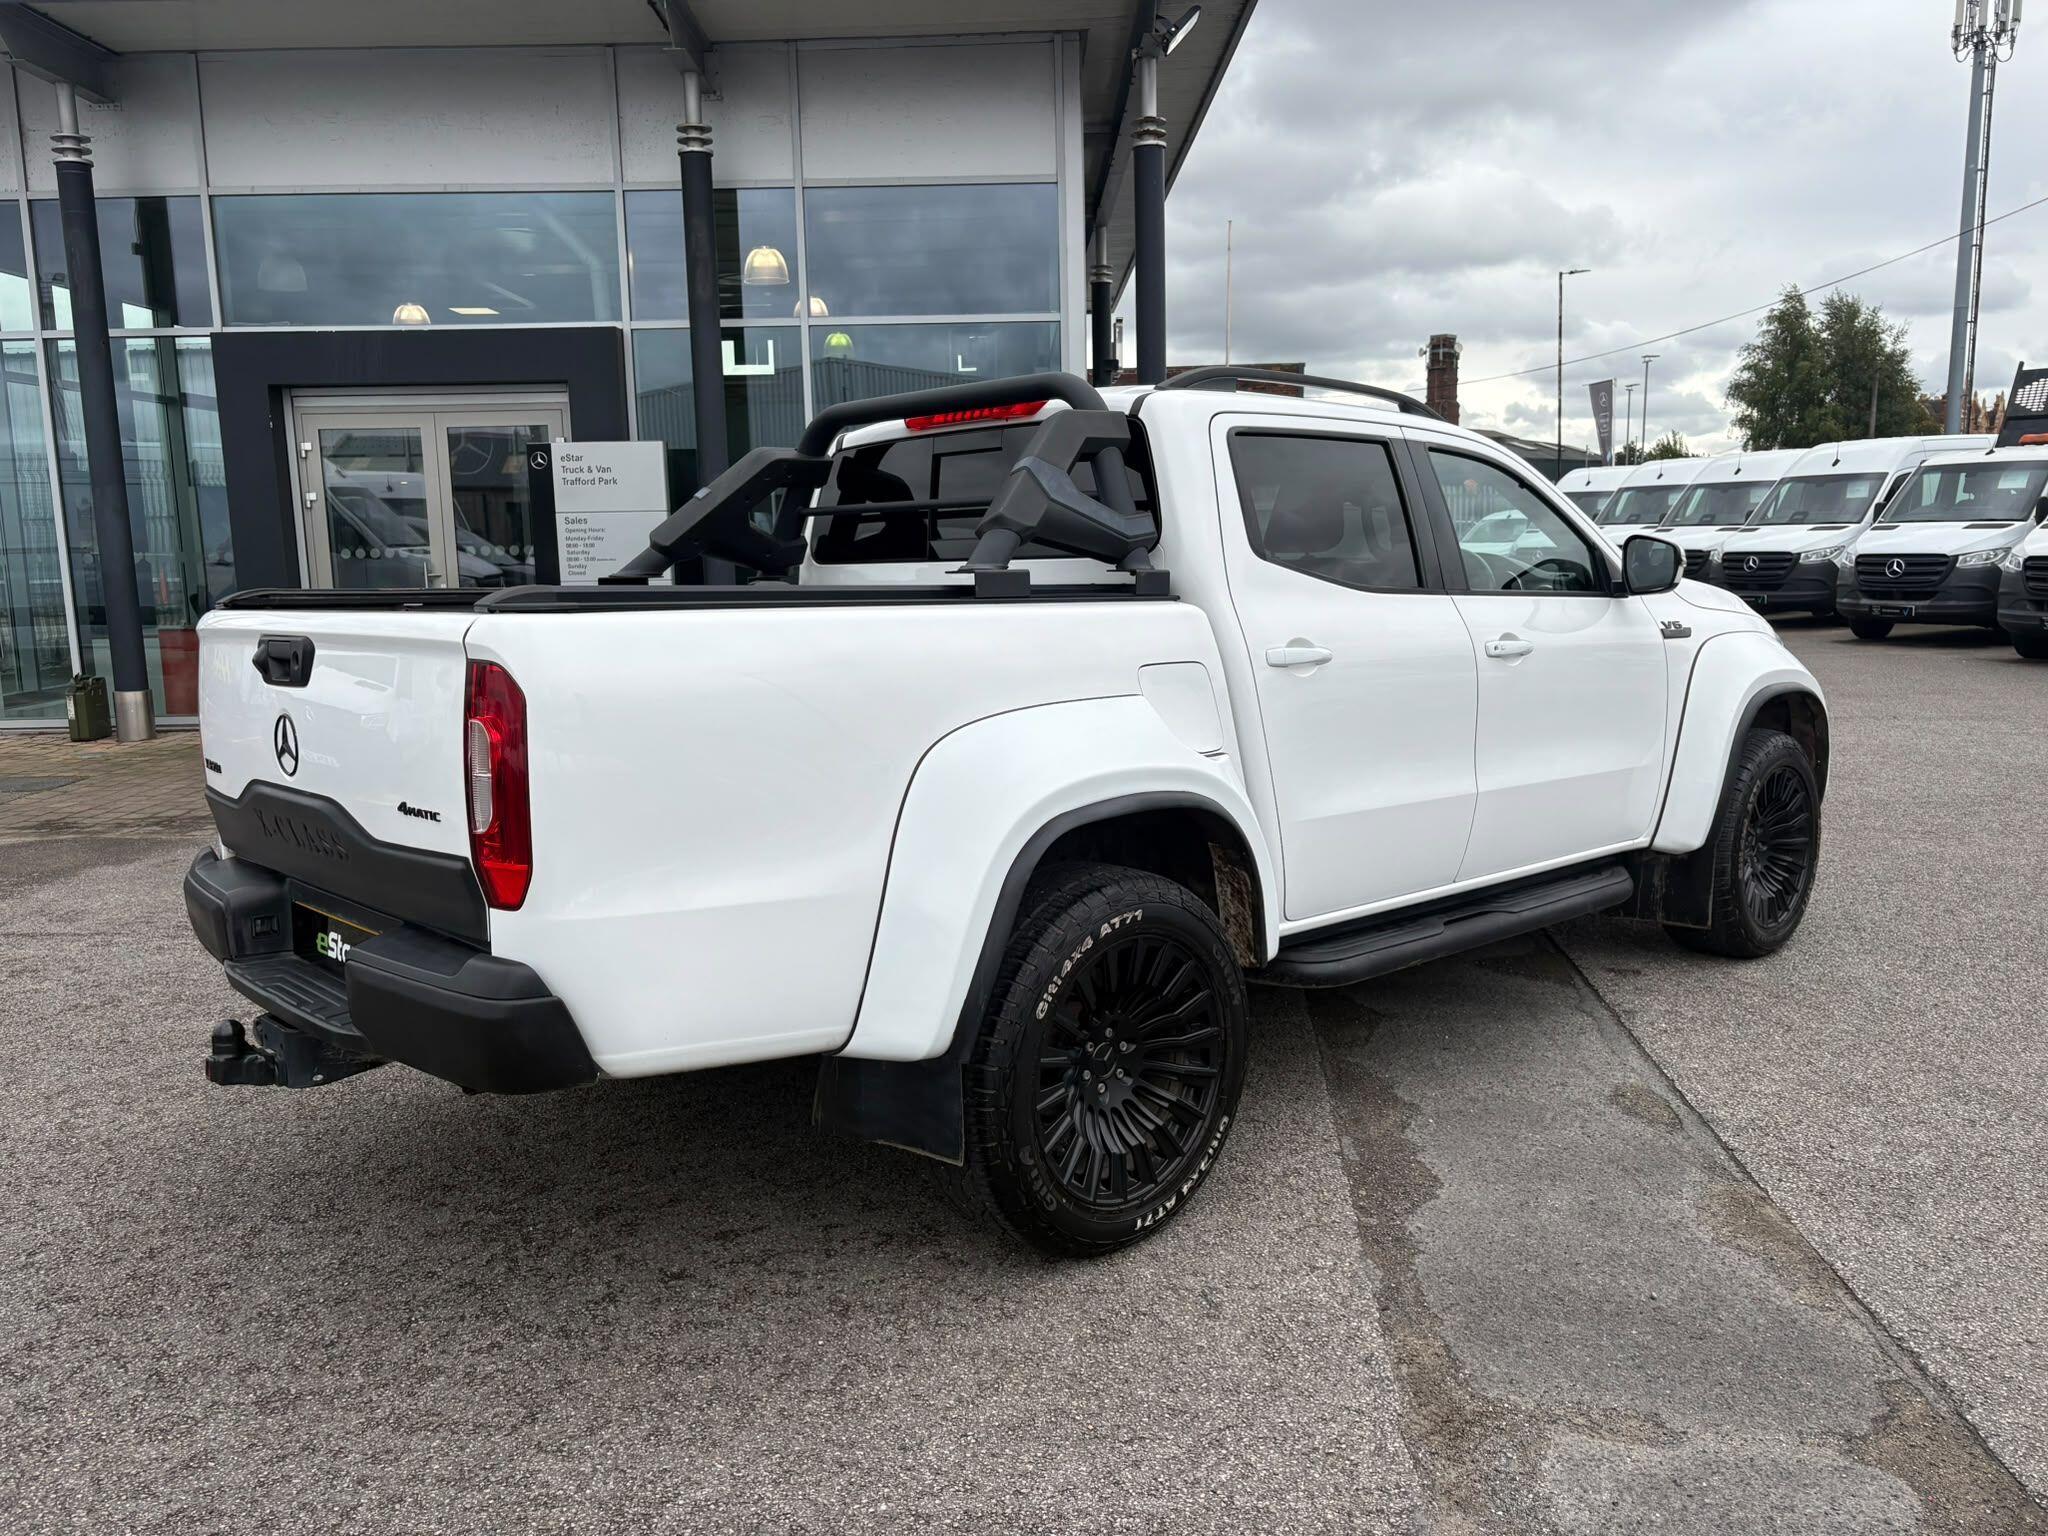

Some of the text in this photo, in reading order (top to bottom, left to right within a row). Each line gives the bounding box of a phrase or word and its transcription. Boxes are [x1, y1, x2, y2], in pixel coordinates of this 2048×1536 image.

[560, 453, 584, 462] eStar
[561, 464, 612, 474] Truck & Van
[561, 476, 618, 486] Trafford Park
[564, 516, 588, 525] Sales
[1660, 620, 1683, 630] V6
